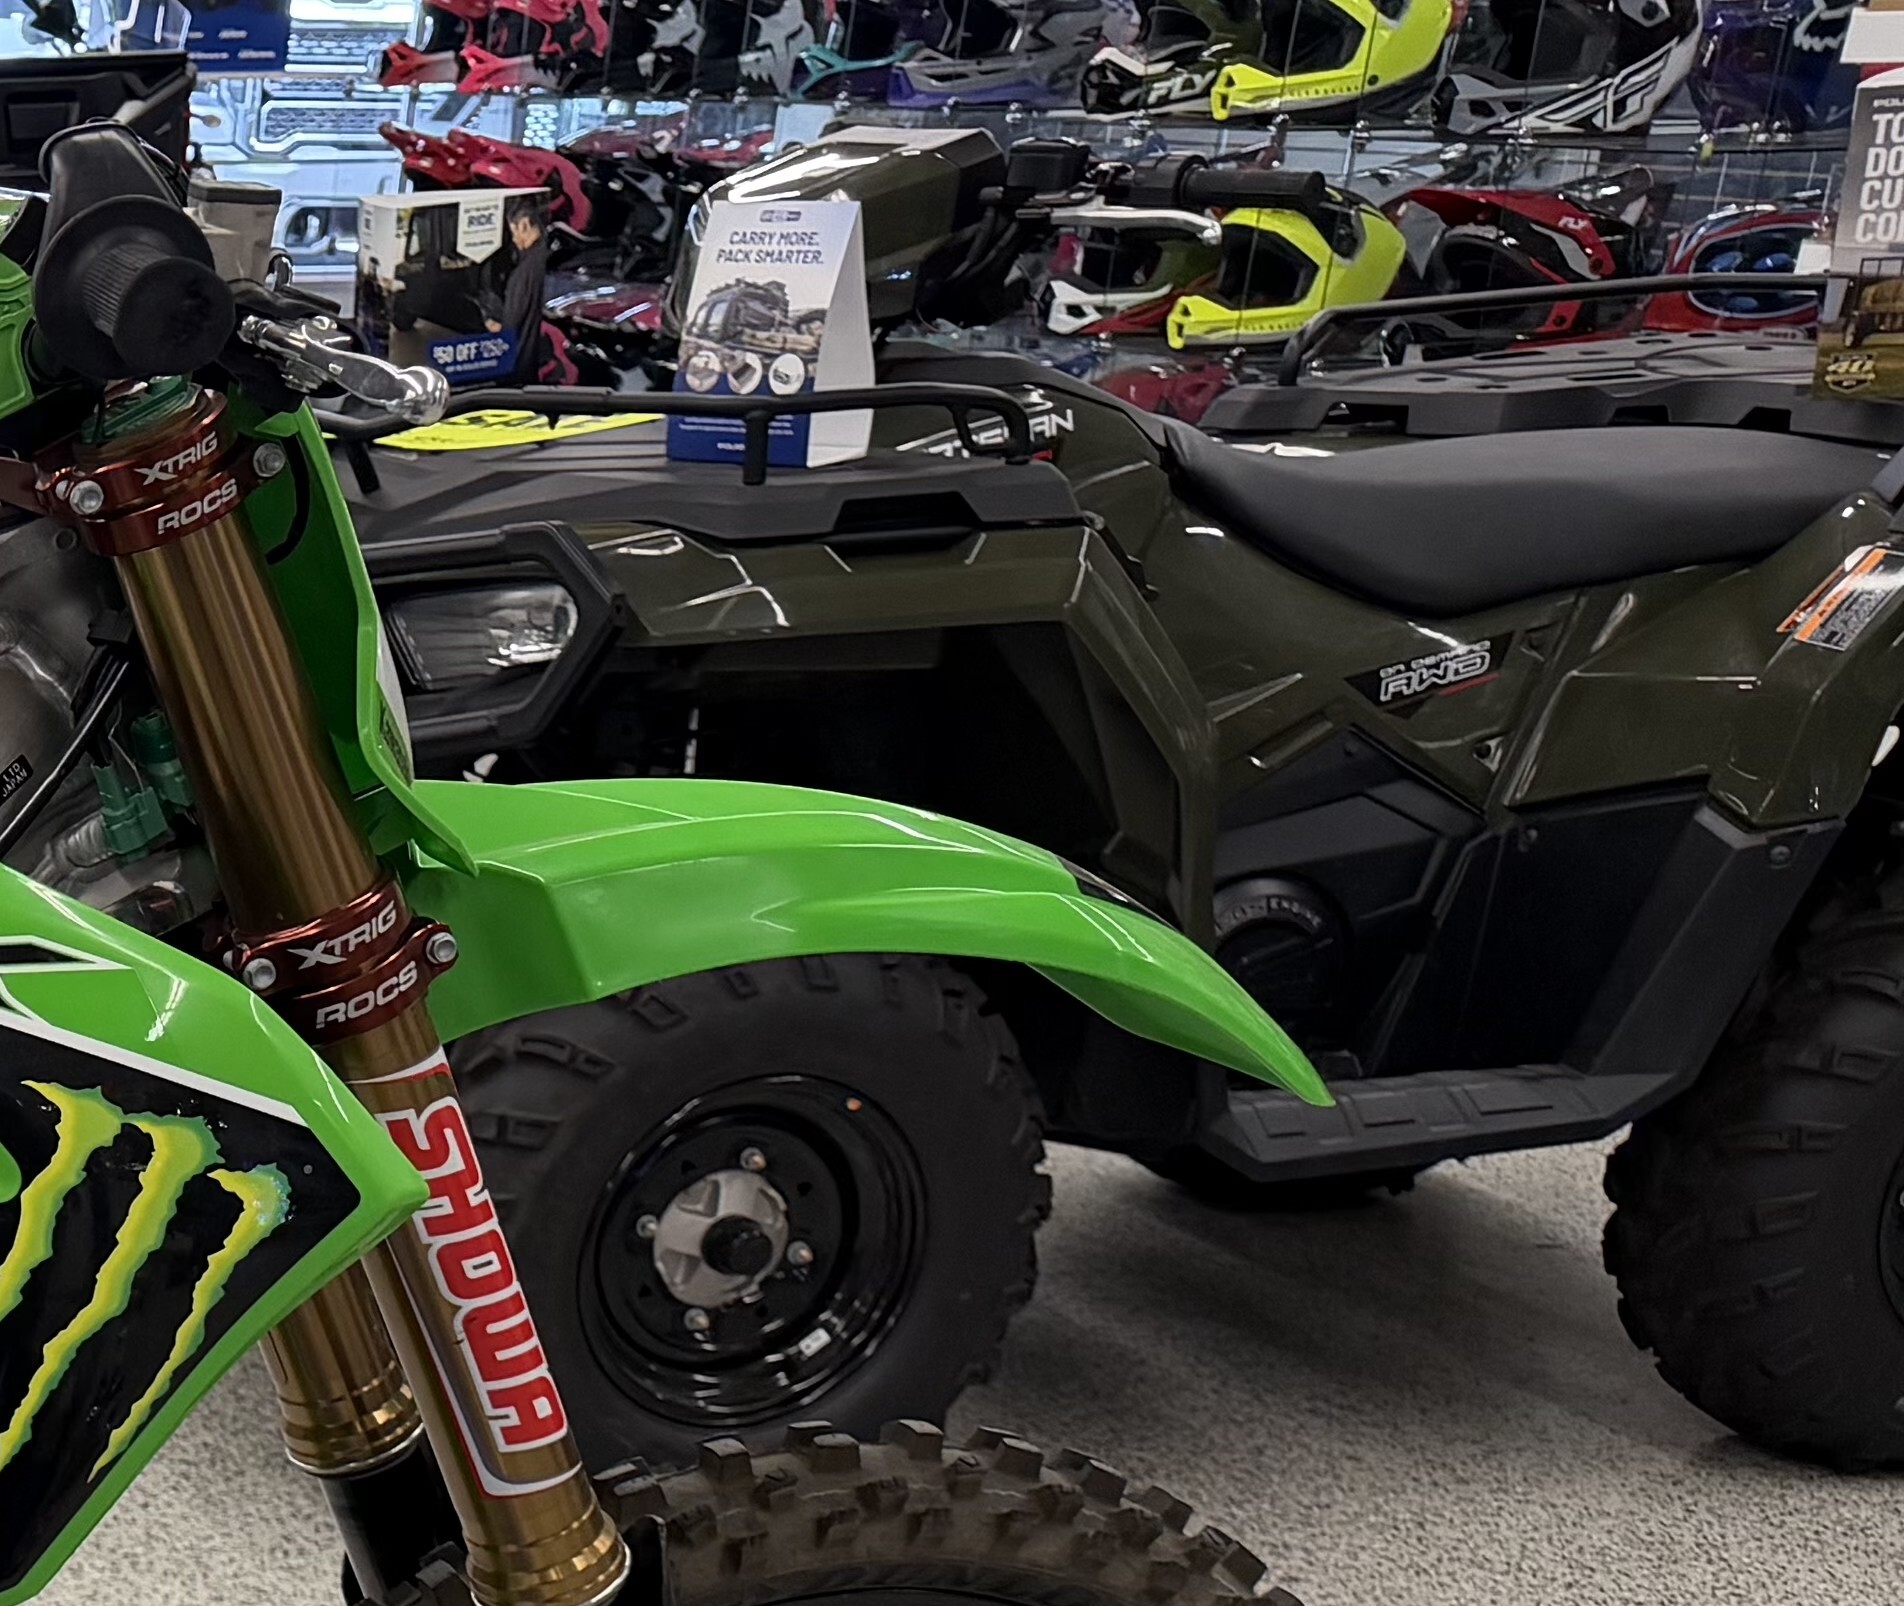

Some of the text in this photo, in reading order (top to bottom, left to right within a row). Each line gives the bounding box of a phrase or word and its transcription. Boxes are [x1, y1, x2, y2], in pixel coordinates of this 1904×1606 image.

[717, 249, 824, 265] PACK SMARTER.
[729, 231, 820, 247] CARRY MORE.
[134, 431, 218, 486] XTRIG
[158, 478, 238, 535] ROCS
[1380, 651, 1491, 702] AWD
[2, 768, 28, 798] JAPAN
[286, 900, 397, 971] XTRIG
[316, 960, 418, 1029] ROCS
[378, 1095, 571, 1454] SHOWA
